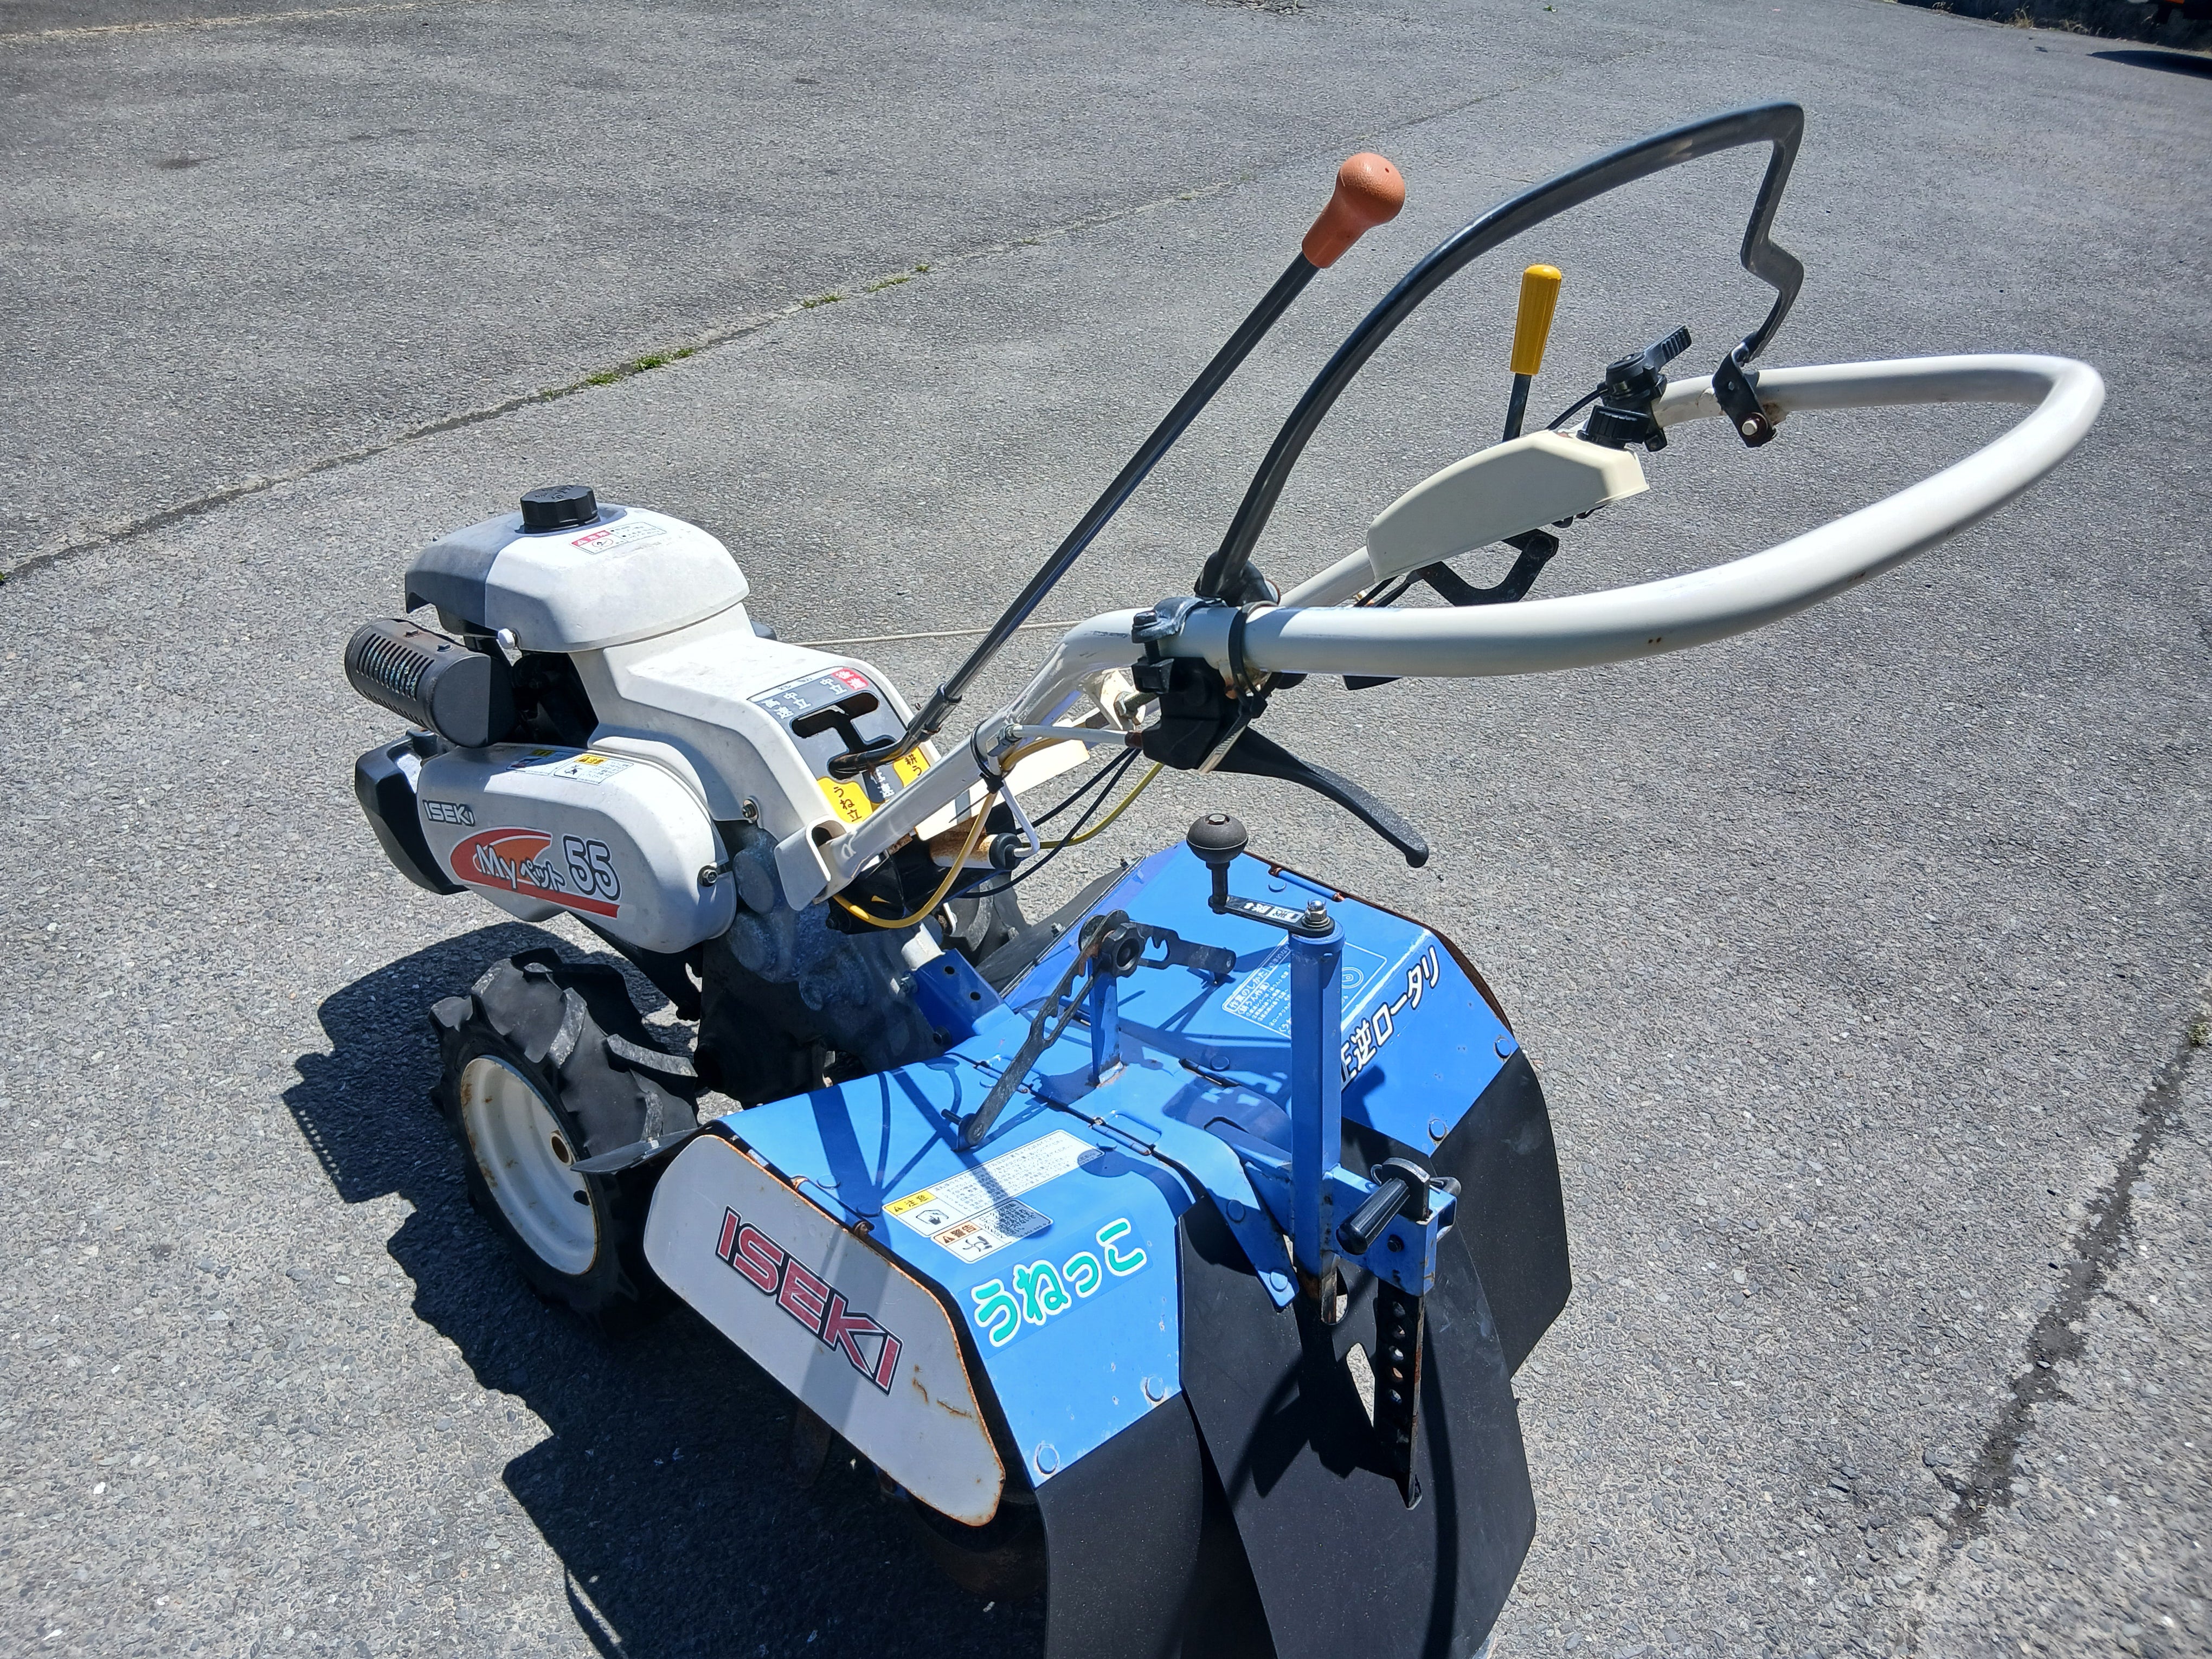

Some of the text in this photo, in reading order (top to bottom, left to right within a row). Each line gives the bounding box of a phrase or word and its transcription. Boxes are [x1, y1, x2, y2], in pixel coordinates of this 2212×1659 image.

[819, 678, 847, 695] 中立
[783, 692, 812, 710] 中立
[904, 754, 923, 776] 耕う
[423, 800, 475, 826] ISEKI
[833, 786, 862, 822] うね立
[475, 834, 621, 902] My ペット 55
[1229, 970, 1268, 1009] 作業のしかた
[904, 1184, 929, 1207] 注意
[950, 1224, 977, 1238] 警告
[972, 1218, 1146, 1347] うねっこ
[715, 1205, 904, 1396] ISEKI
